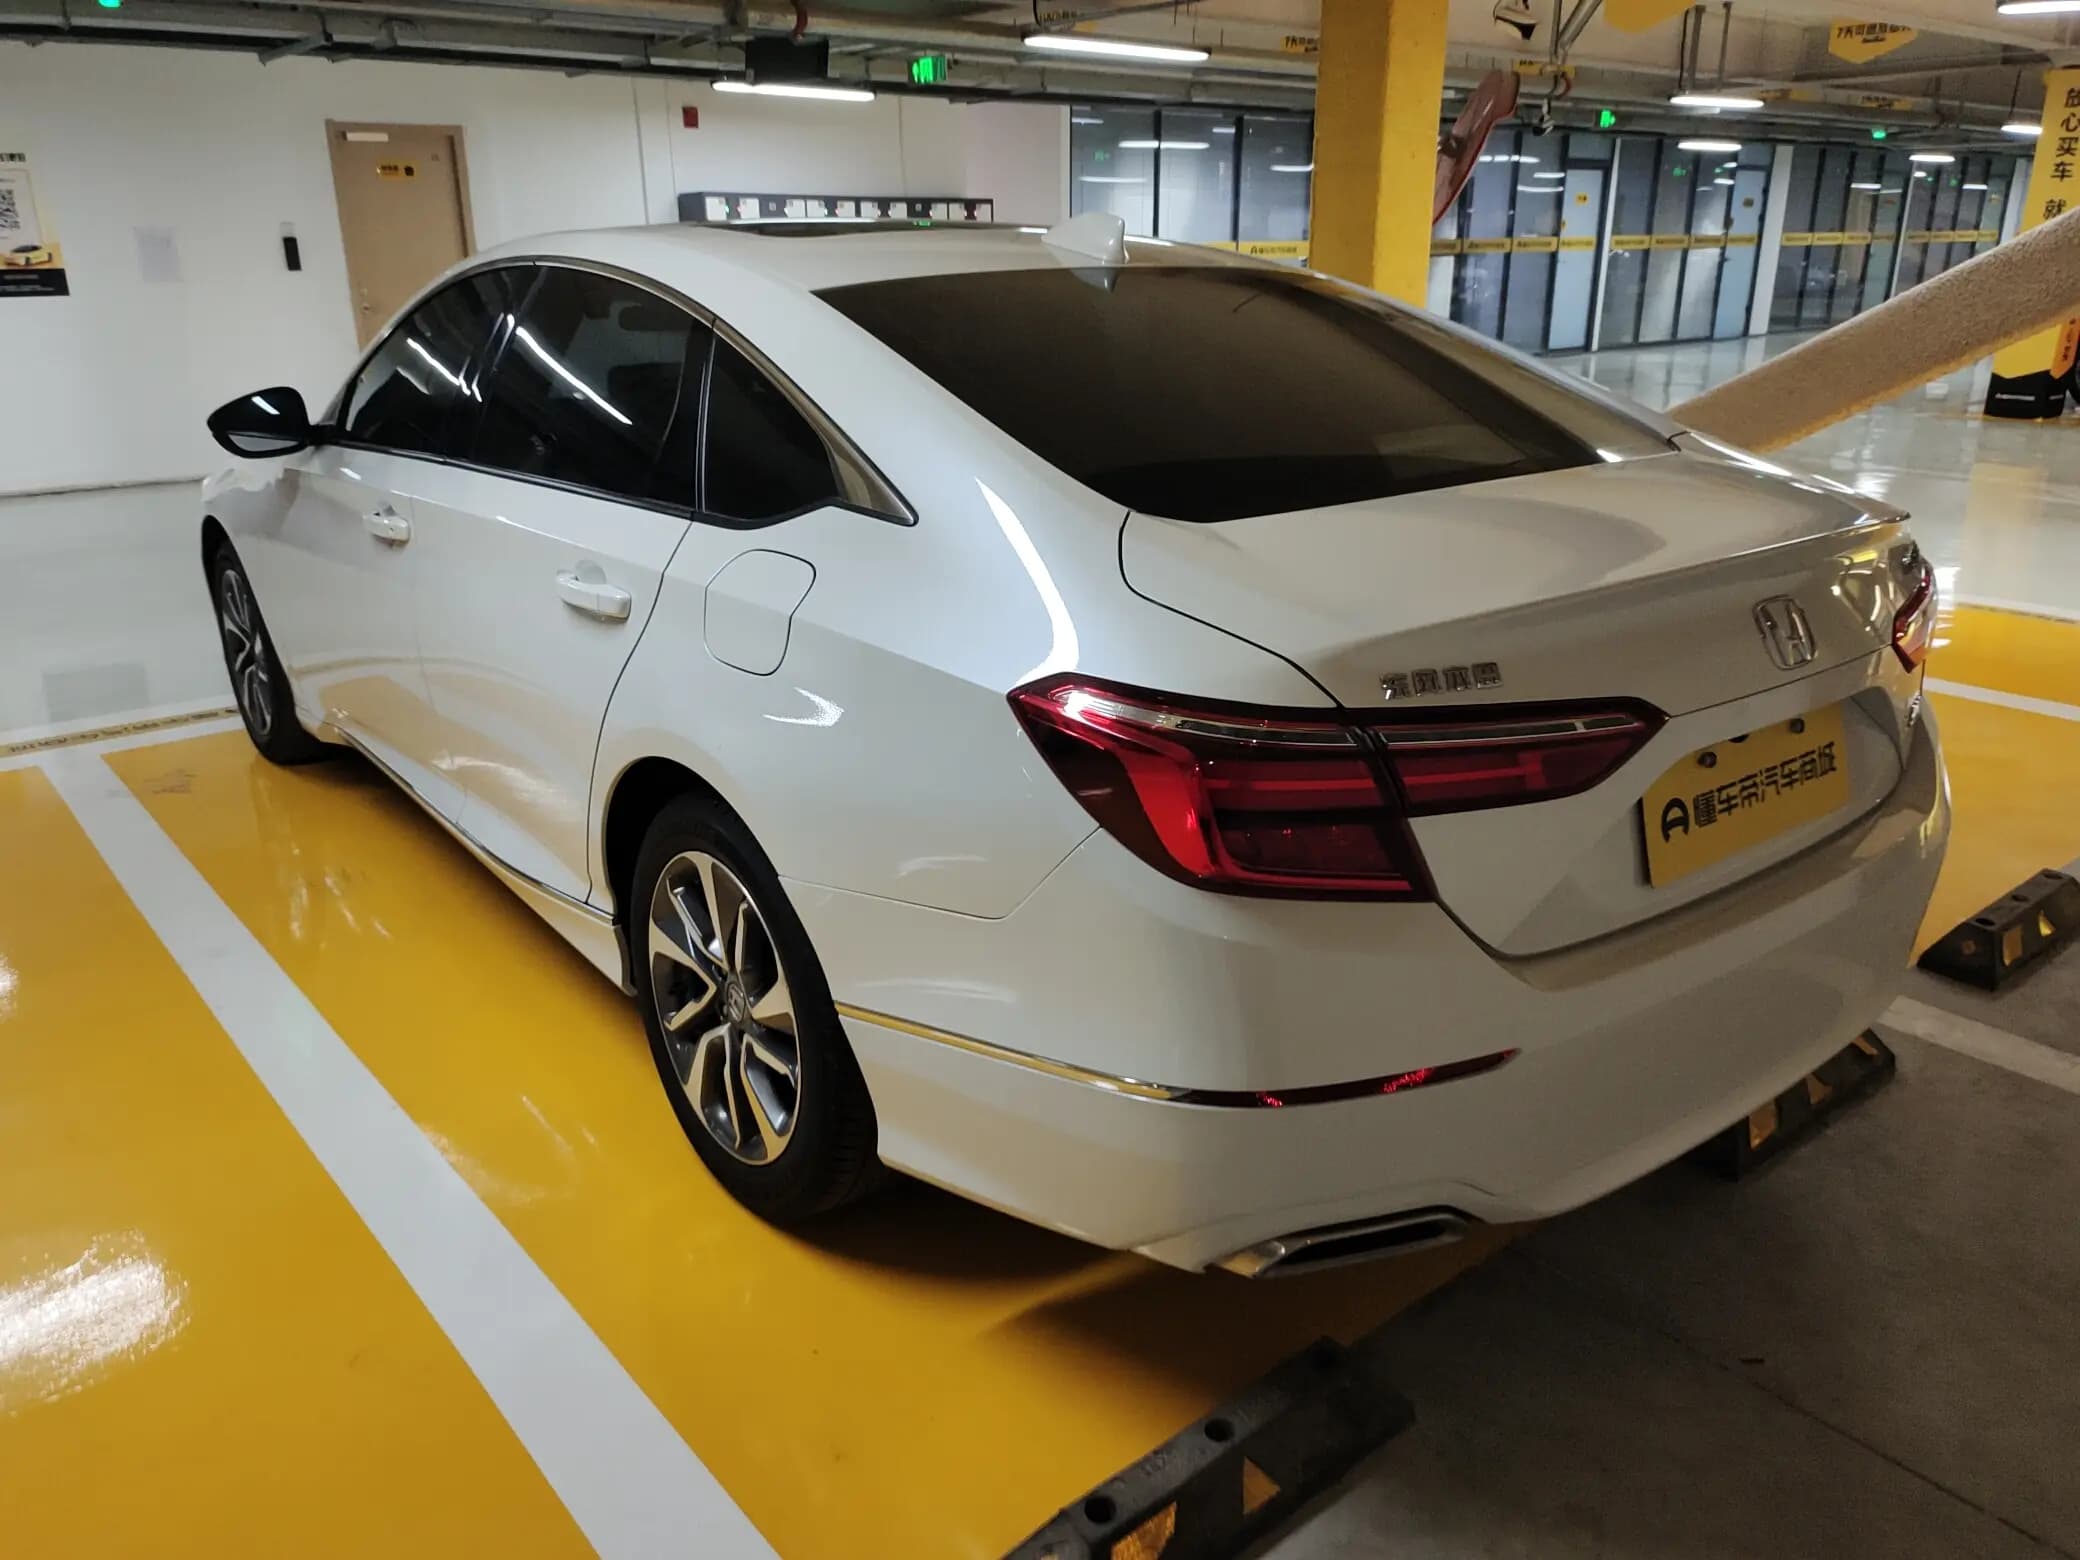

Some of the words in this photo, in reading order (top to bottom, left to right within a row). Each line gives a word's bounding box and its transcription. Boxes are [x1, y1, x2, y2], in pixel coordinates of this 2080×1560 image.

[1379, 661, 1502, 700] 东风本田
[1693, 741, 1837, 829] 懂车帝汽车商城
